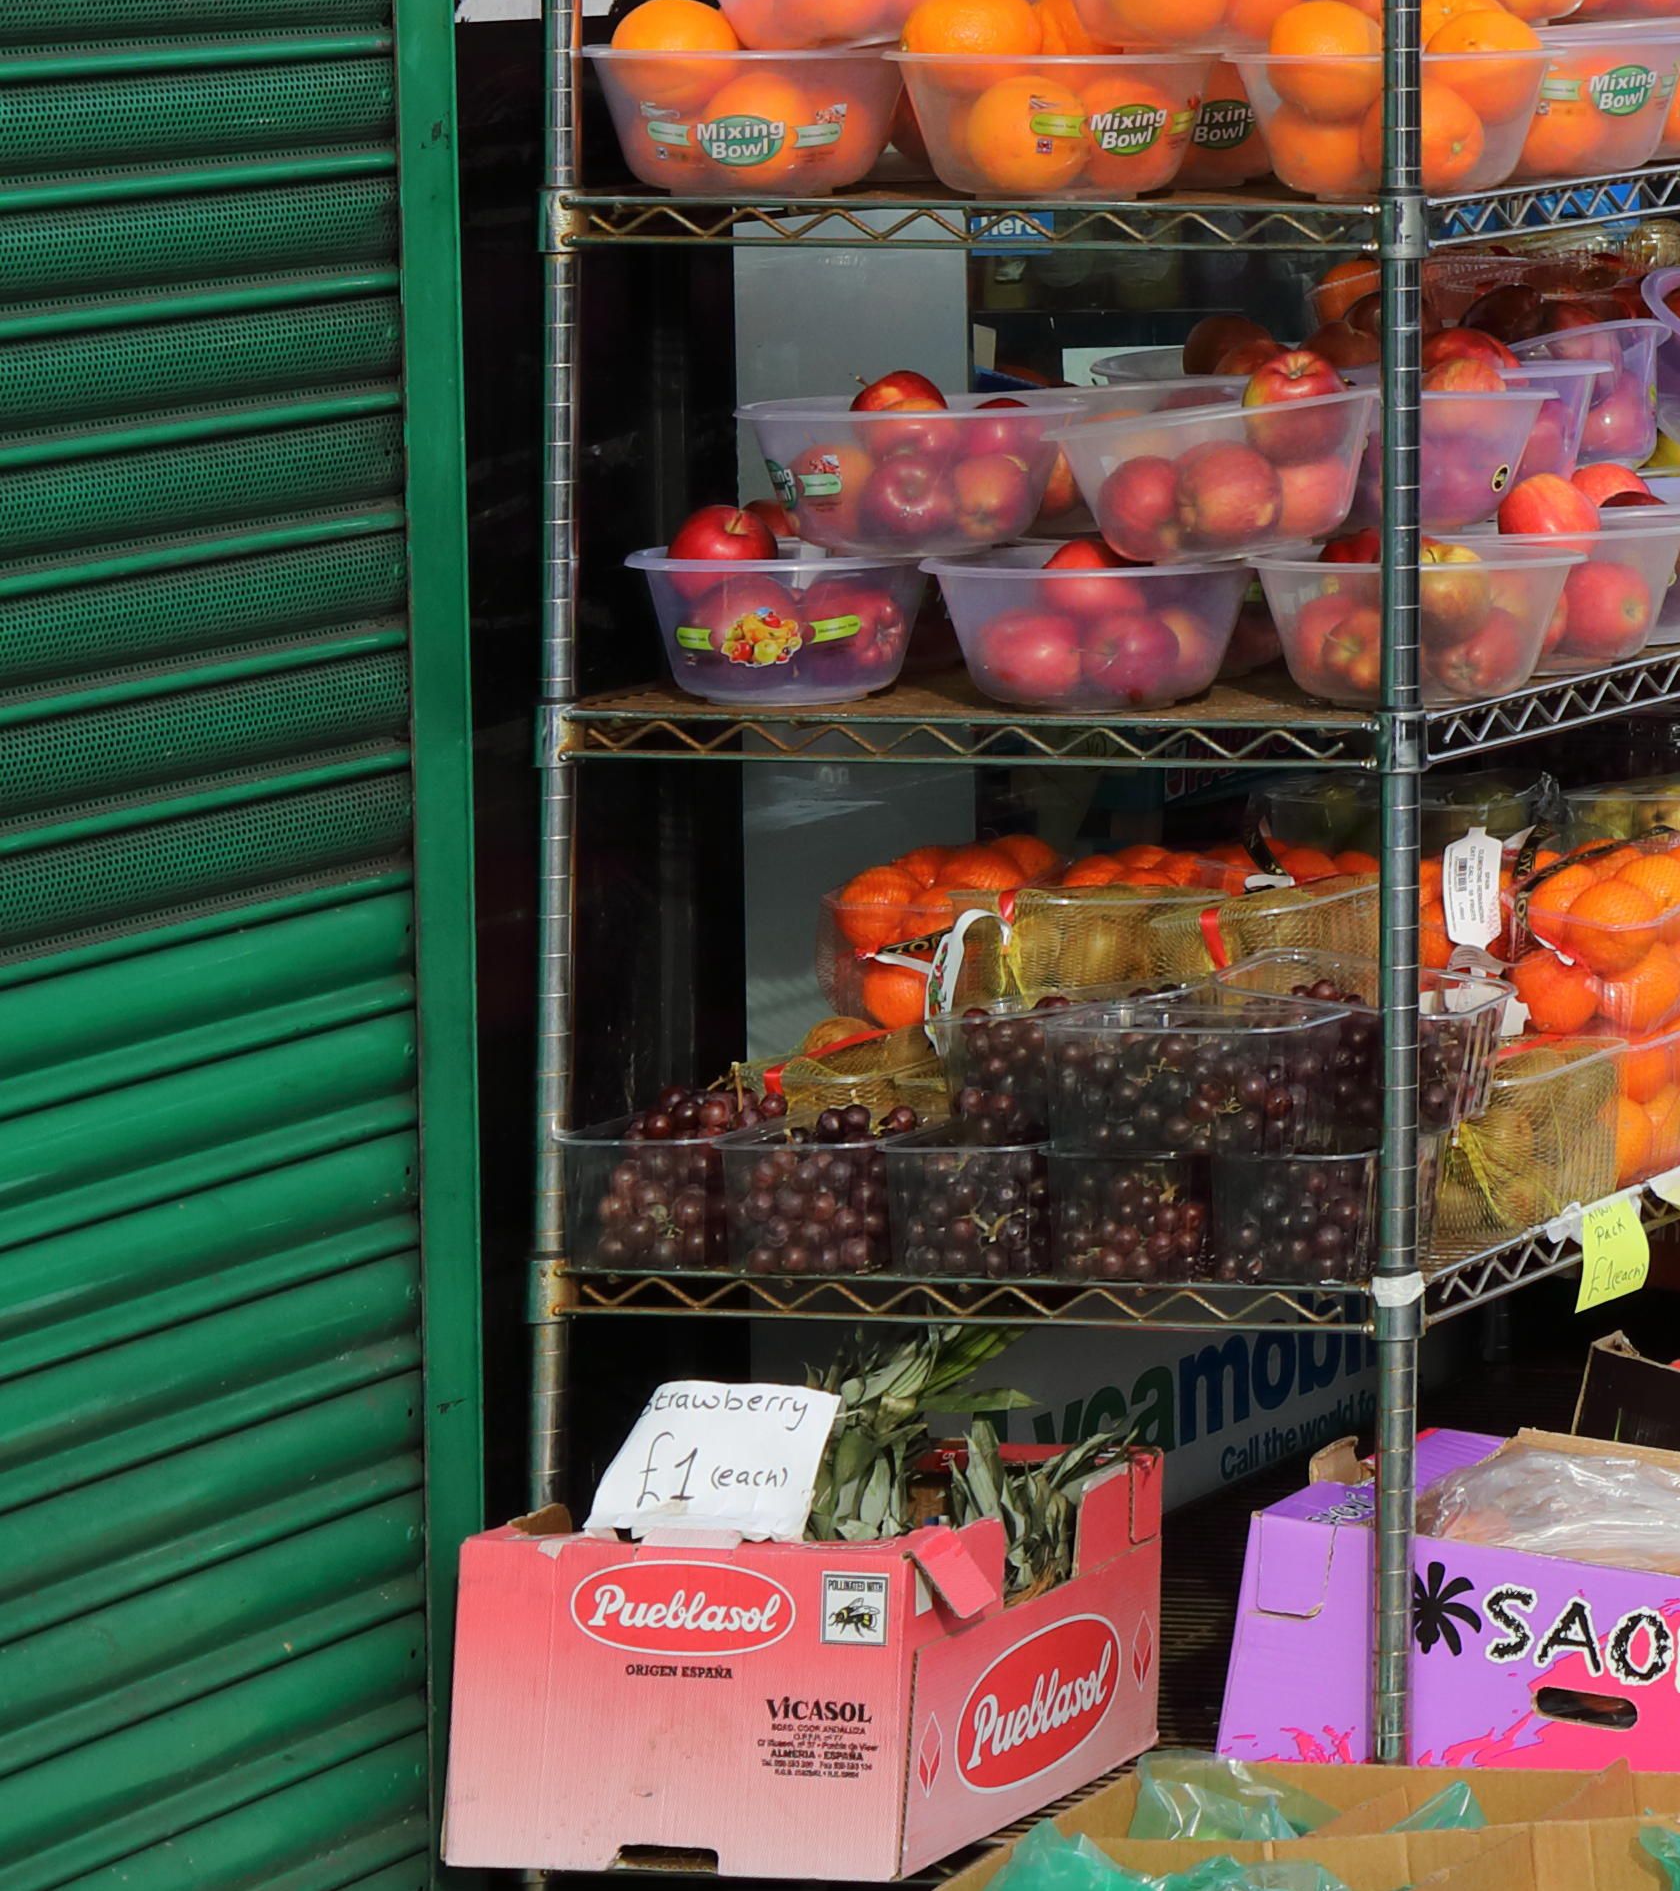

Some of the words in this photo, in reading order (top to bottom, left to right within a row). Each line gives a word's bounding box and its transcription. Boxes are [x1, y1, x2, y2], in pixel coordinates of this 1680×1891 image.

[1590, 68, 1658, 92] Mixing
[1599, 89, 1645, 109] Bowl
[697, 118, 785, 140] Mixing
[1090, 108, 1167, 131] Mixing
[711, 139, 769, 160] Bowl
[1101, 128, 1153, 150] Bowl
[1221, 1435, 1258, 1481] Call
[1262, 1421, 1299, 1463] the
[636, 1430, 698, 1507] £1
[710, 1463, 789, 1491] (each)
[589, 1583, 779, 1634] Pueblasol
[625, 1663, 677, 1678] ORIGEN
[681, 1662, 733, 1680] ESPAÑA
[965, 1652, 1109, 1775] Pueblasol
